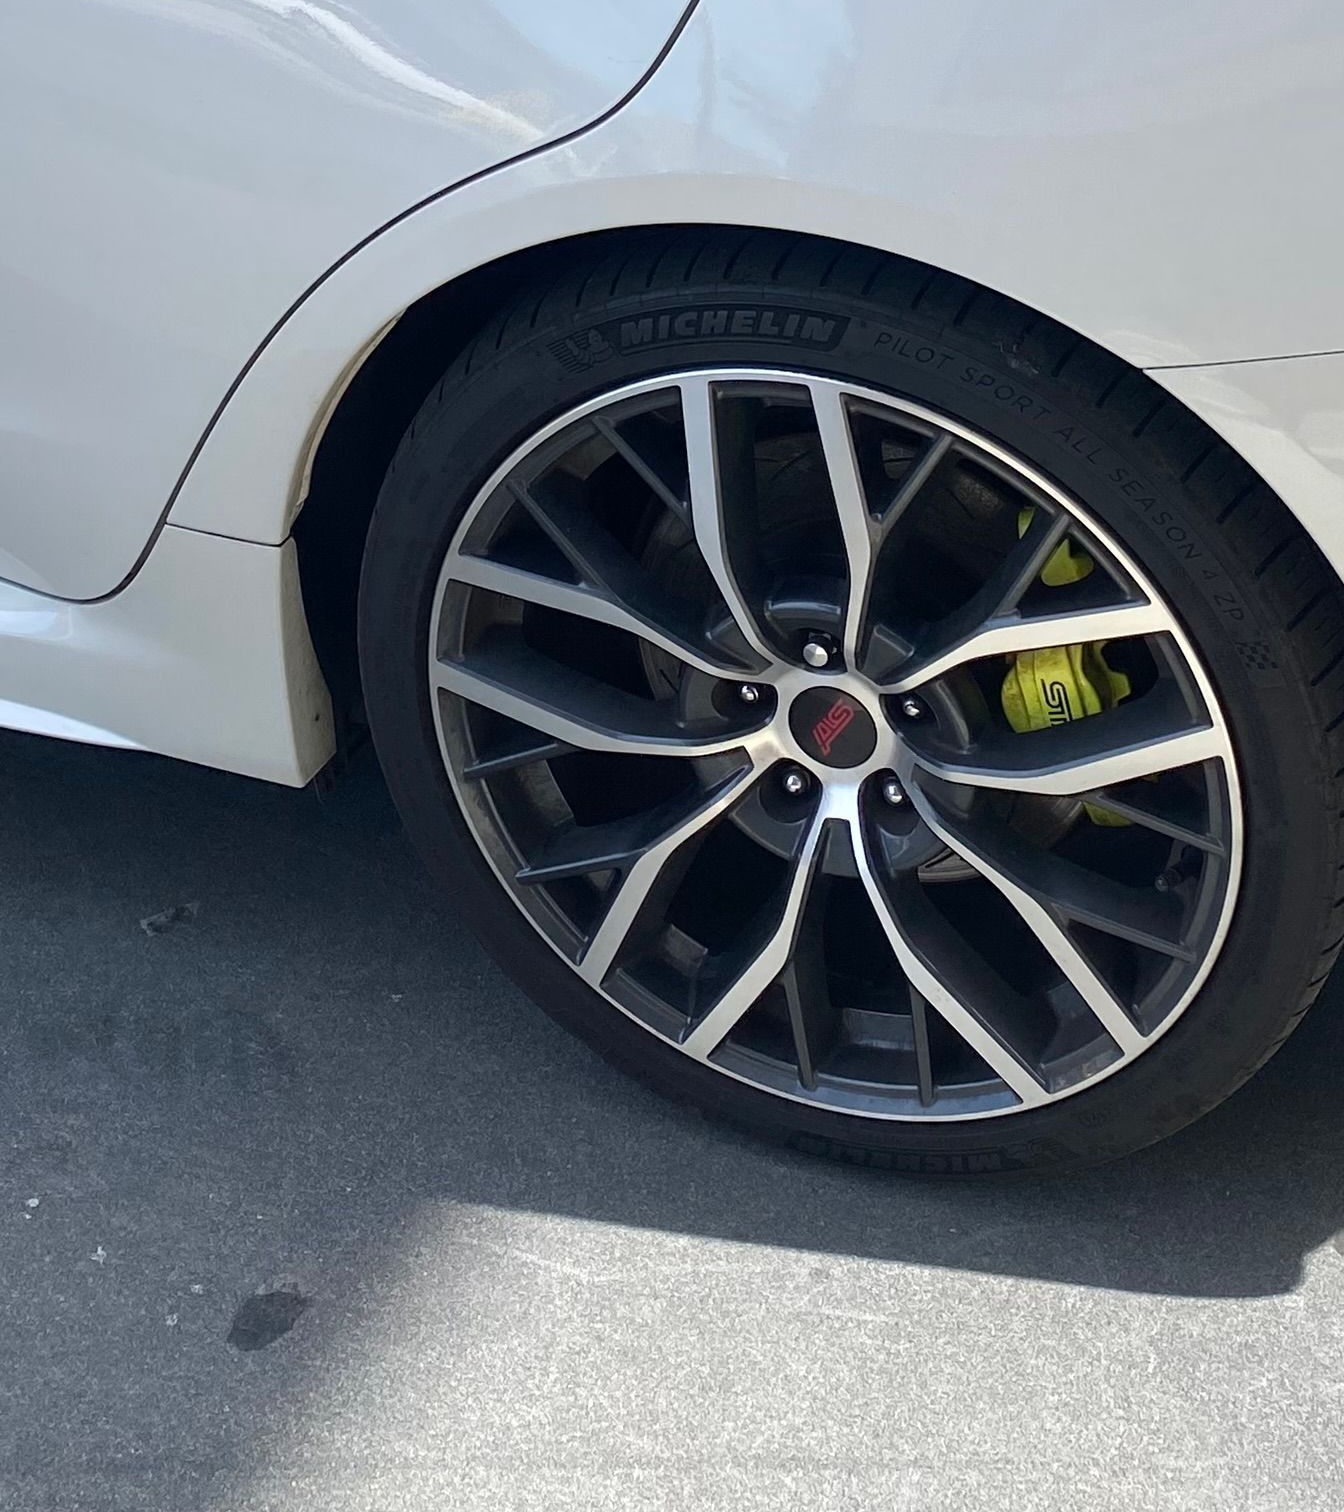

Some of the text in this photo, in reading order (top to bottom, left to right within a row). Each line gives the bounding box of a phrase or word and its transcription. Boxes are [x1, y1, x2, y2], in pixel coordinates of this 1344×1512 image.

[618, 309, 838, 347] MICHELIN
[873, 331, 955, 371] PILOT
[958, 365, 1054, 422] SPORT
[1054, 424, 1100, 467] ALL
[1107, 467, 1204, 561] SEASON
